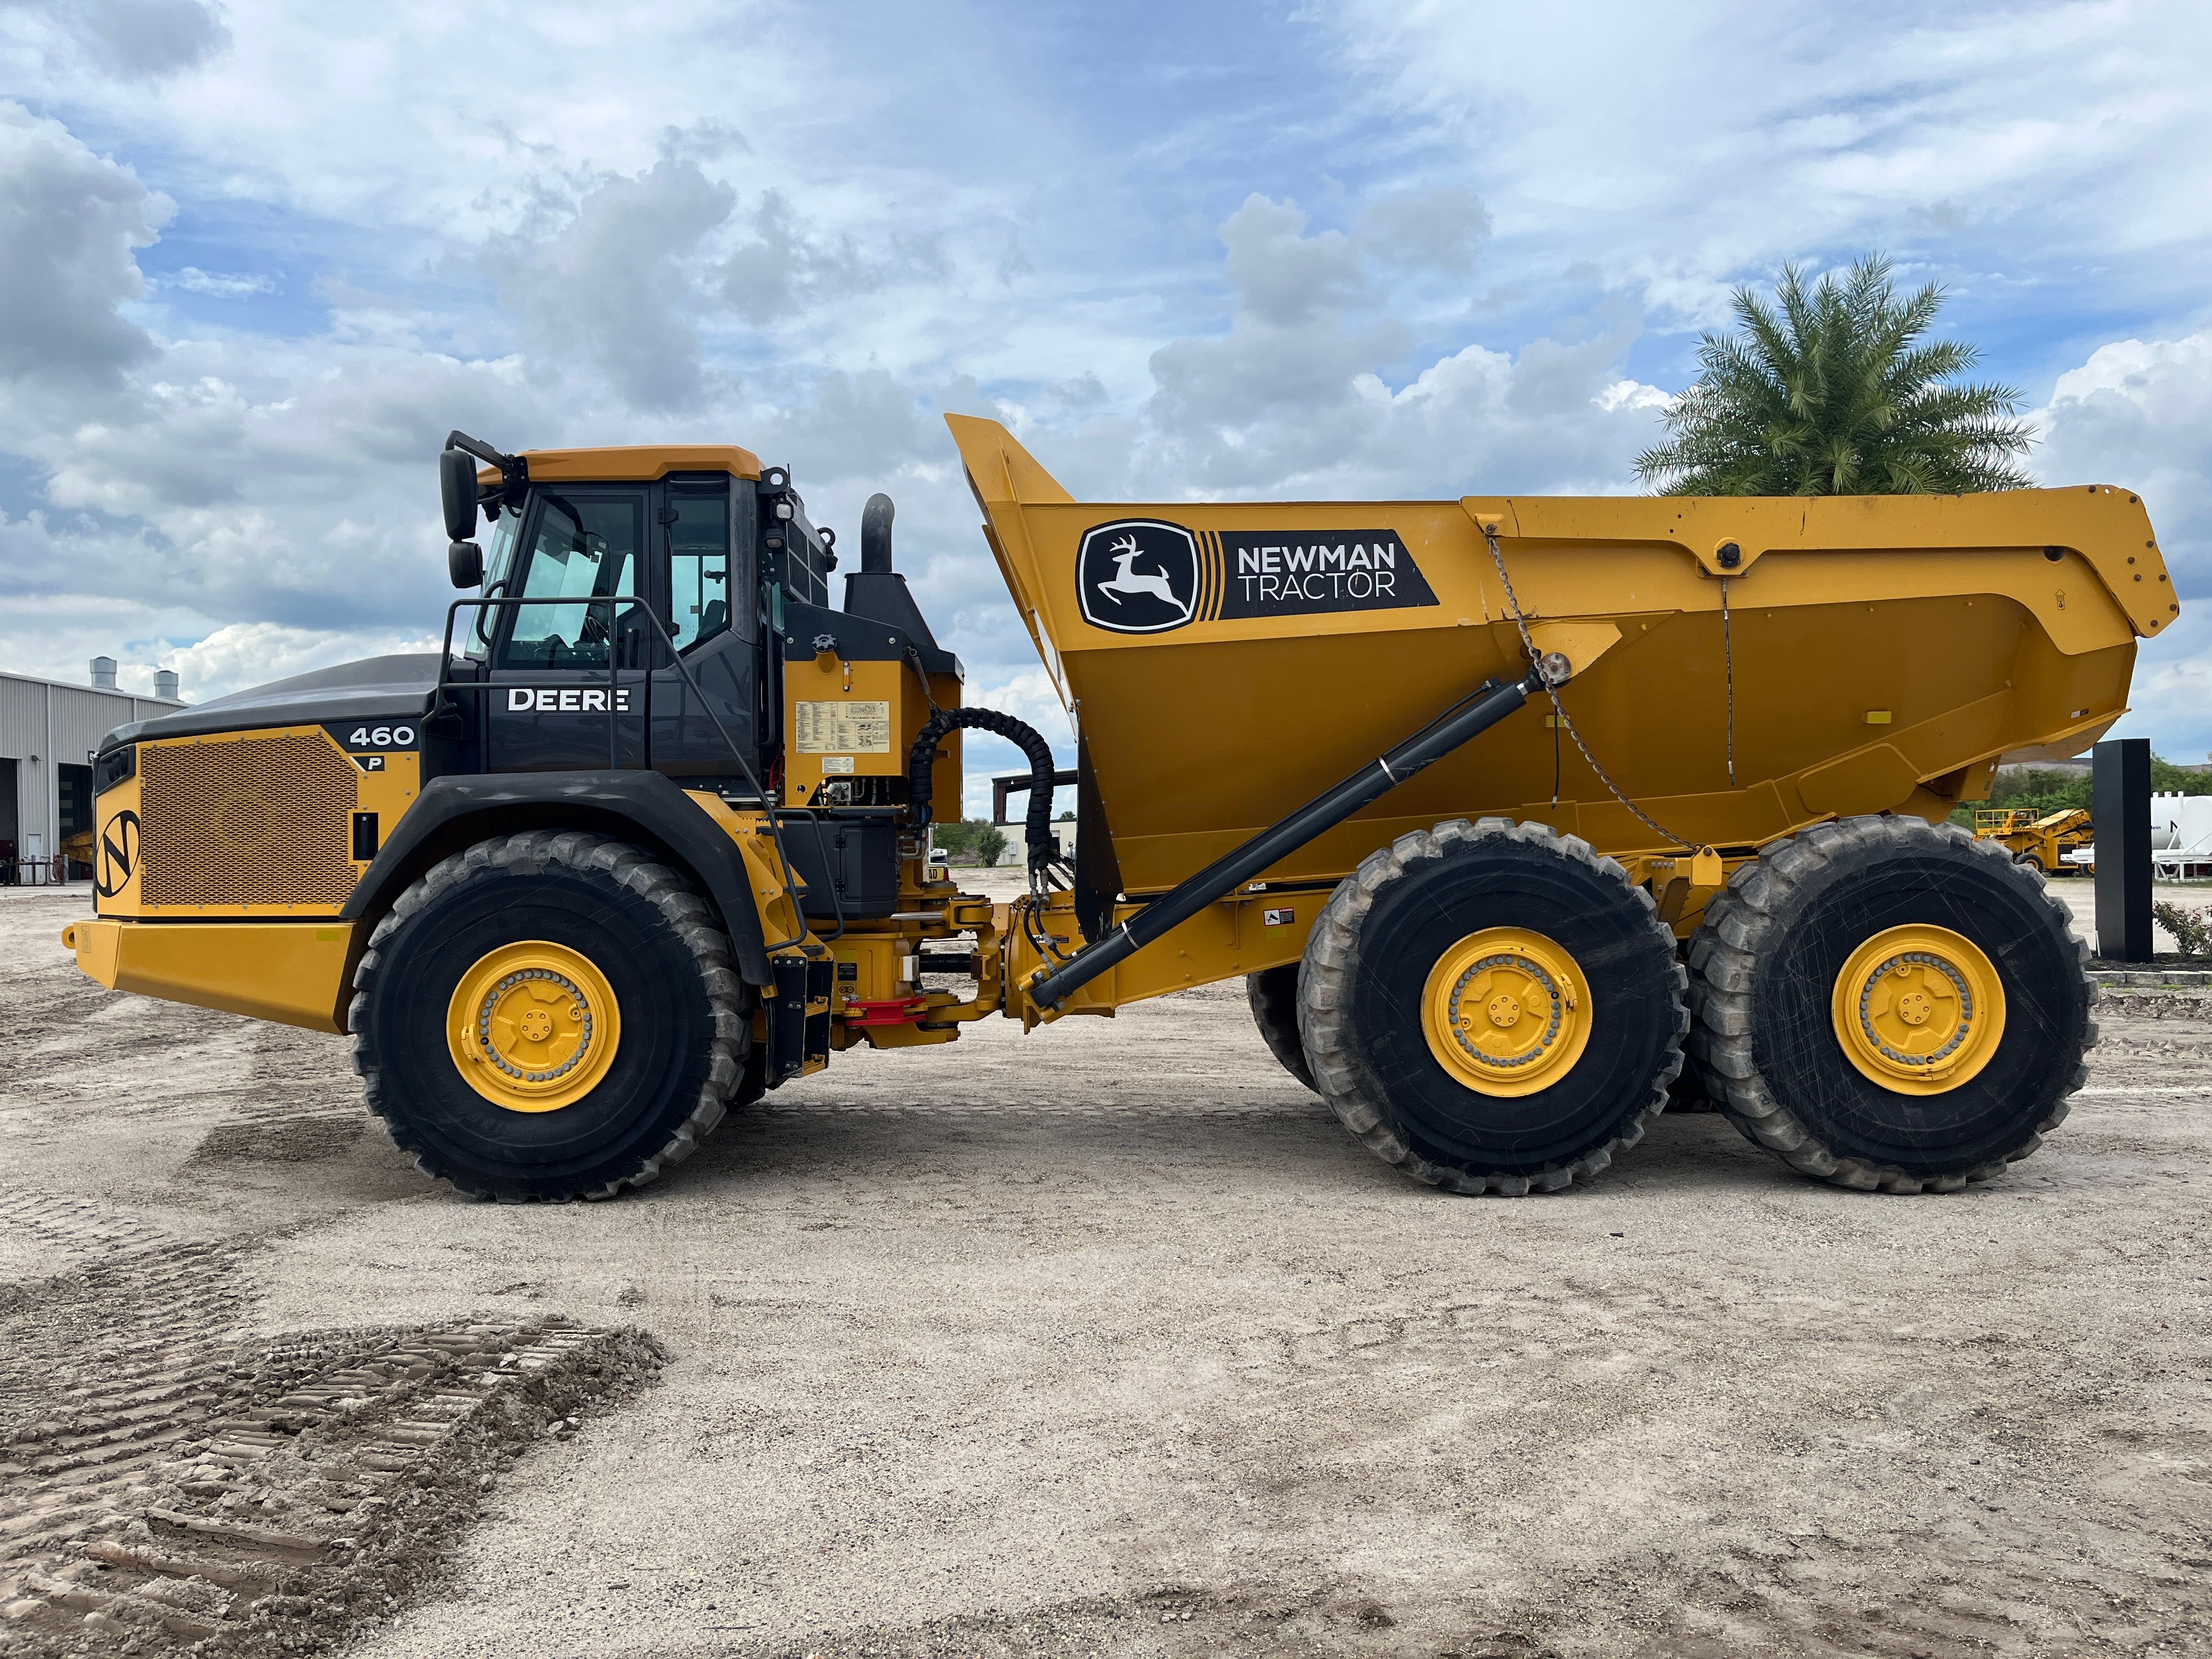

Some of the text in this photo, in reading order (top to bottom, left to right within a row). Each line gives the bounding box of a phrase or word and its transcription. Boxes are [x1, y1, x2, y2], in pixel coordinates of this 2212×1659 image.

[1238, 543, 1395, 573] NEWMAN
[1237, 571, 1396, 601] TRACTOR
[508, 689, 629, 710] DEERE
[350, 726, 415, 746] 460
[368, 758, 382, 770] P
